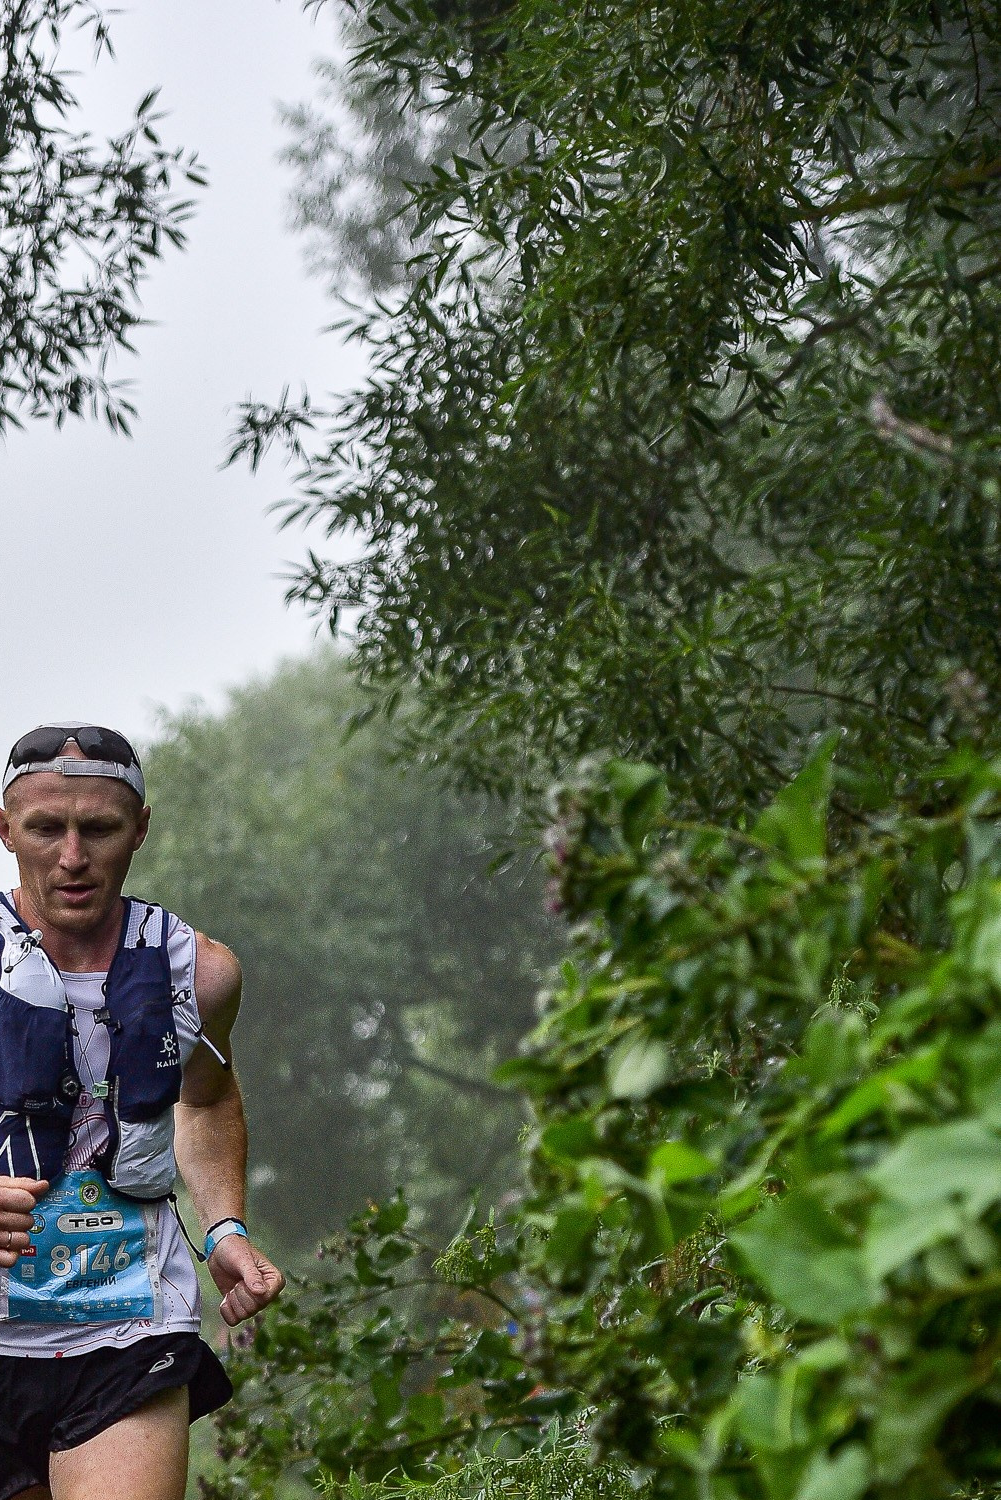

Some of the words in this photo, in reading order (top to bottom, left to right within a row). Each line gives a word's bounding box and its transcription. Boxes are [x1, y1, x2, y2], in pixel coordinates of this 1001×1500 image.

[156, 1058, 179, 1068] KAILA
[69, 1216, 114, 1228] T80
[50, 1240, 131, 1277] 8146
[65, 1276, 117, 1290] ЕВГЕНИЙ
